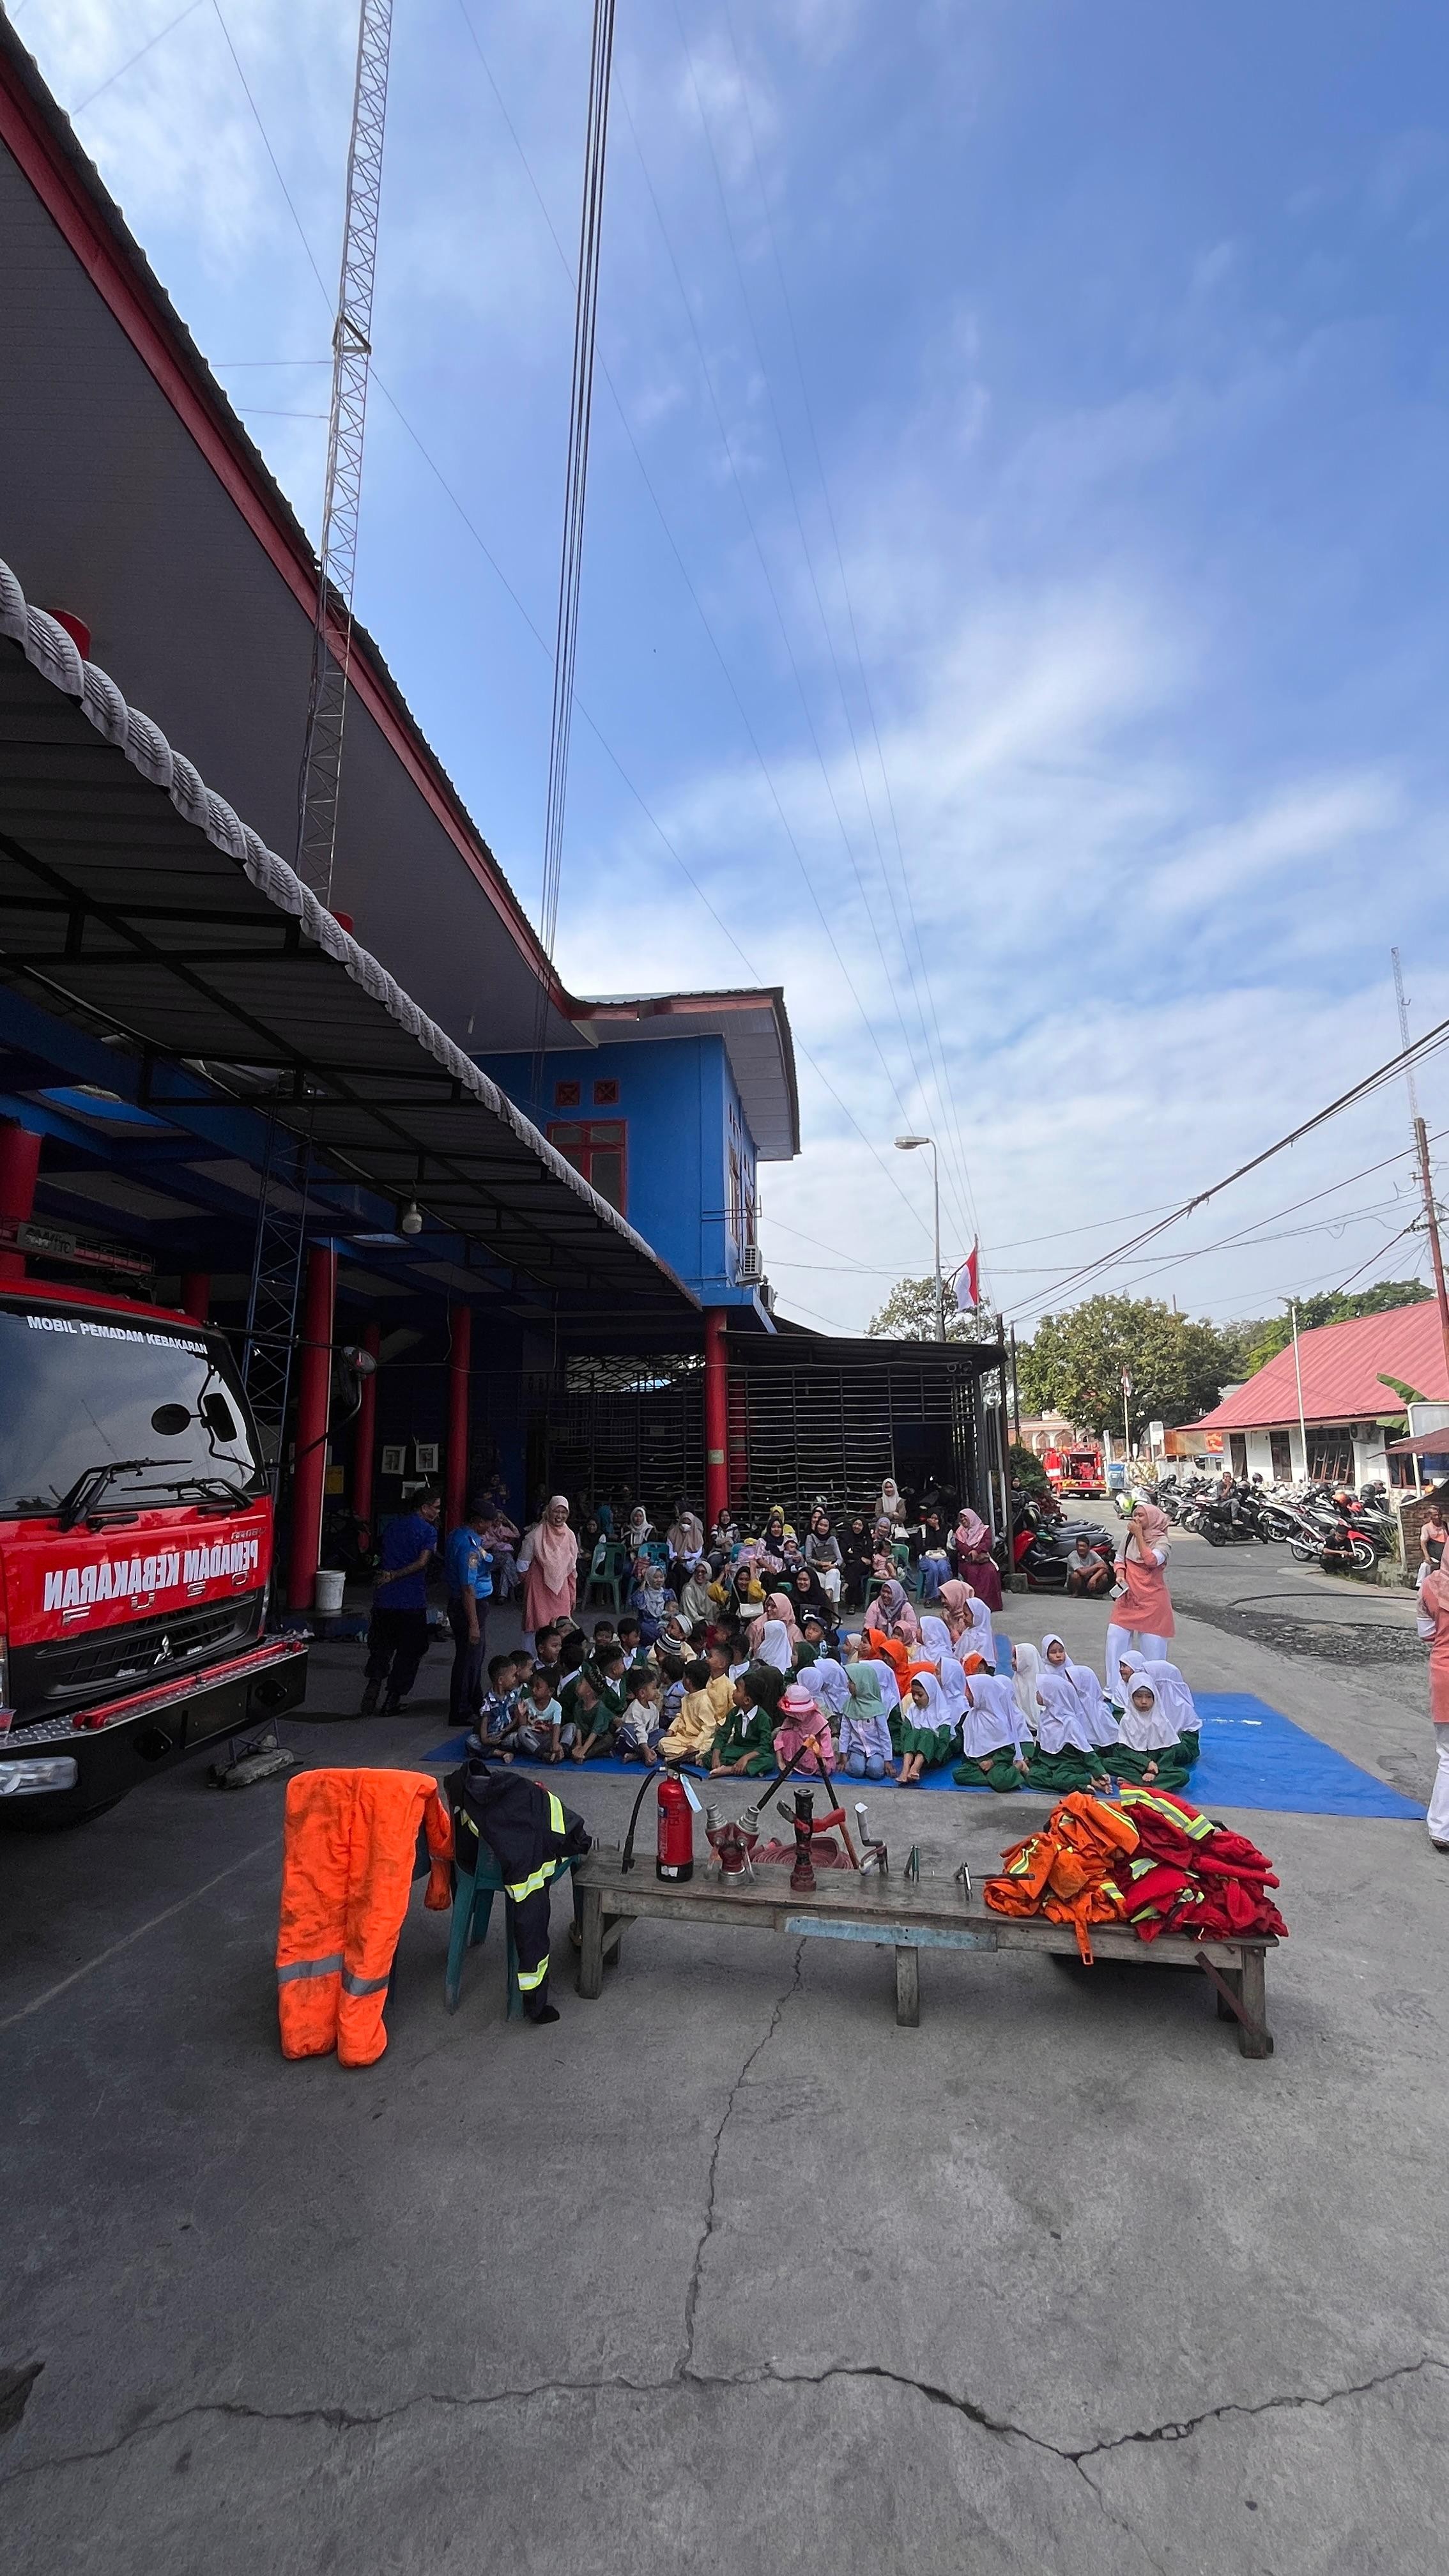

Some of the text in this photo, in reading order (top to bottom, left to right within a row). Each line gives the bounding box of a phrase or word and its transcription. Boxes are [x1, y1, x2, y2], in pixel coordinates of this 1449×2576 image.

[26, 1315, 208, 1354] MOBIL PEMADAM KEBAKARAN
[62, 1571, 249, 1626] FUSO
